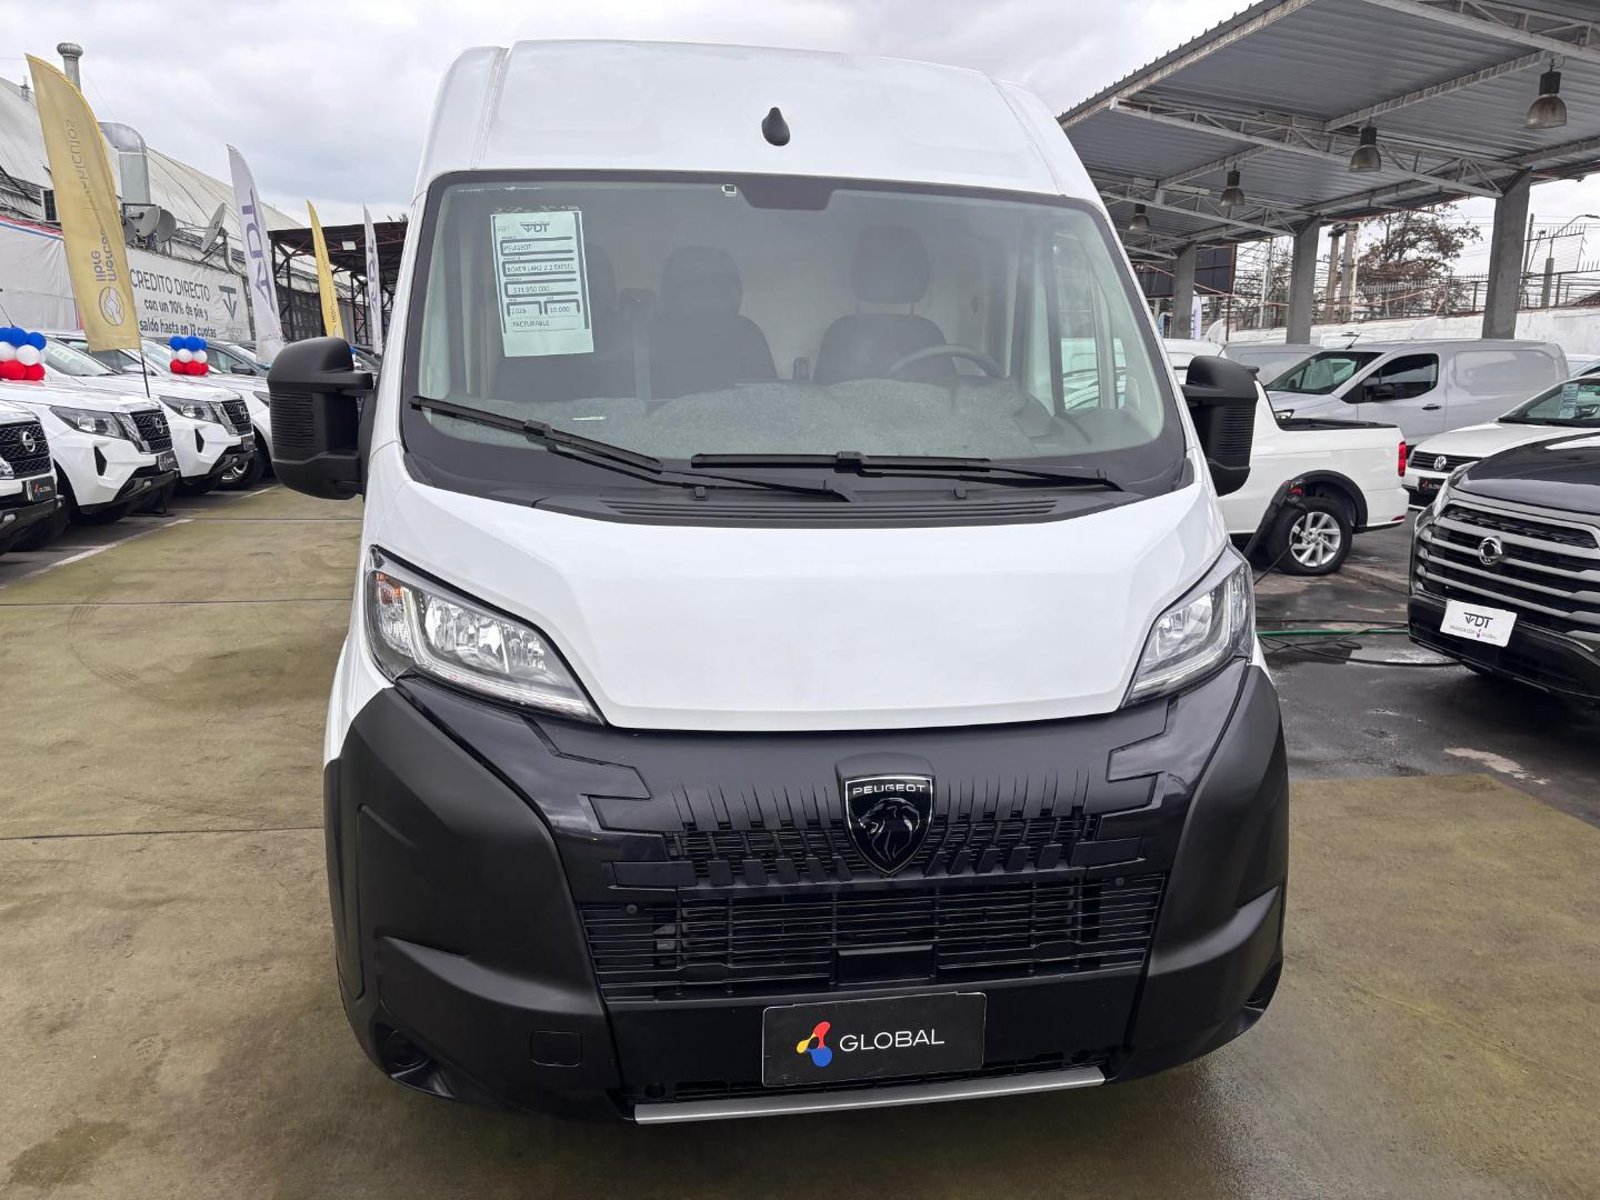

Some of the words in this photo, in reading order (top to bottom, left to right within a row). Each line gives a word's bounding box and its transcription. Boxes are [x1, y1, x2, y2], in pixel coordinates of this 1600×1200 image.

[129, 268, 172, 294] CREDITO
[173, 278, 211, 301] DIRECTO
[144, 299, 158, 312] con
[160, 301, 169, 312] un
[185, 301, 193, 316] de
[194, 303, 204, 320] pie
[139, 317, 159, 332] saldo
[160, 319, 179, 334] hasta
[180, 325, 188, 335] en
[190, 323, 196, 336] 12
[197, 324, 217, 338] cuotas
[852, 783, 926, 796] PEUGEOT
[839, 1028, 945, 1052] GLOBAL
